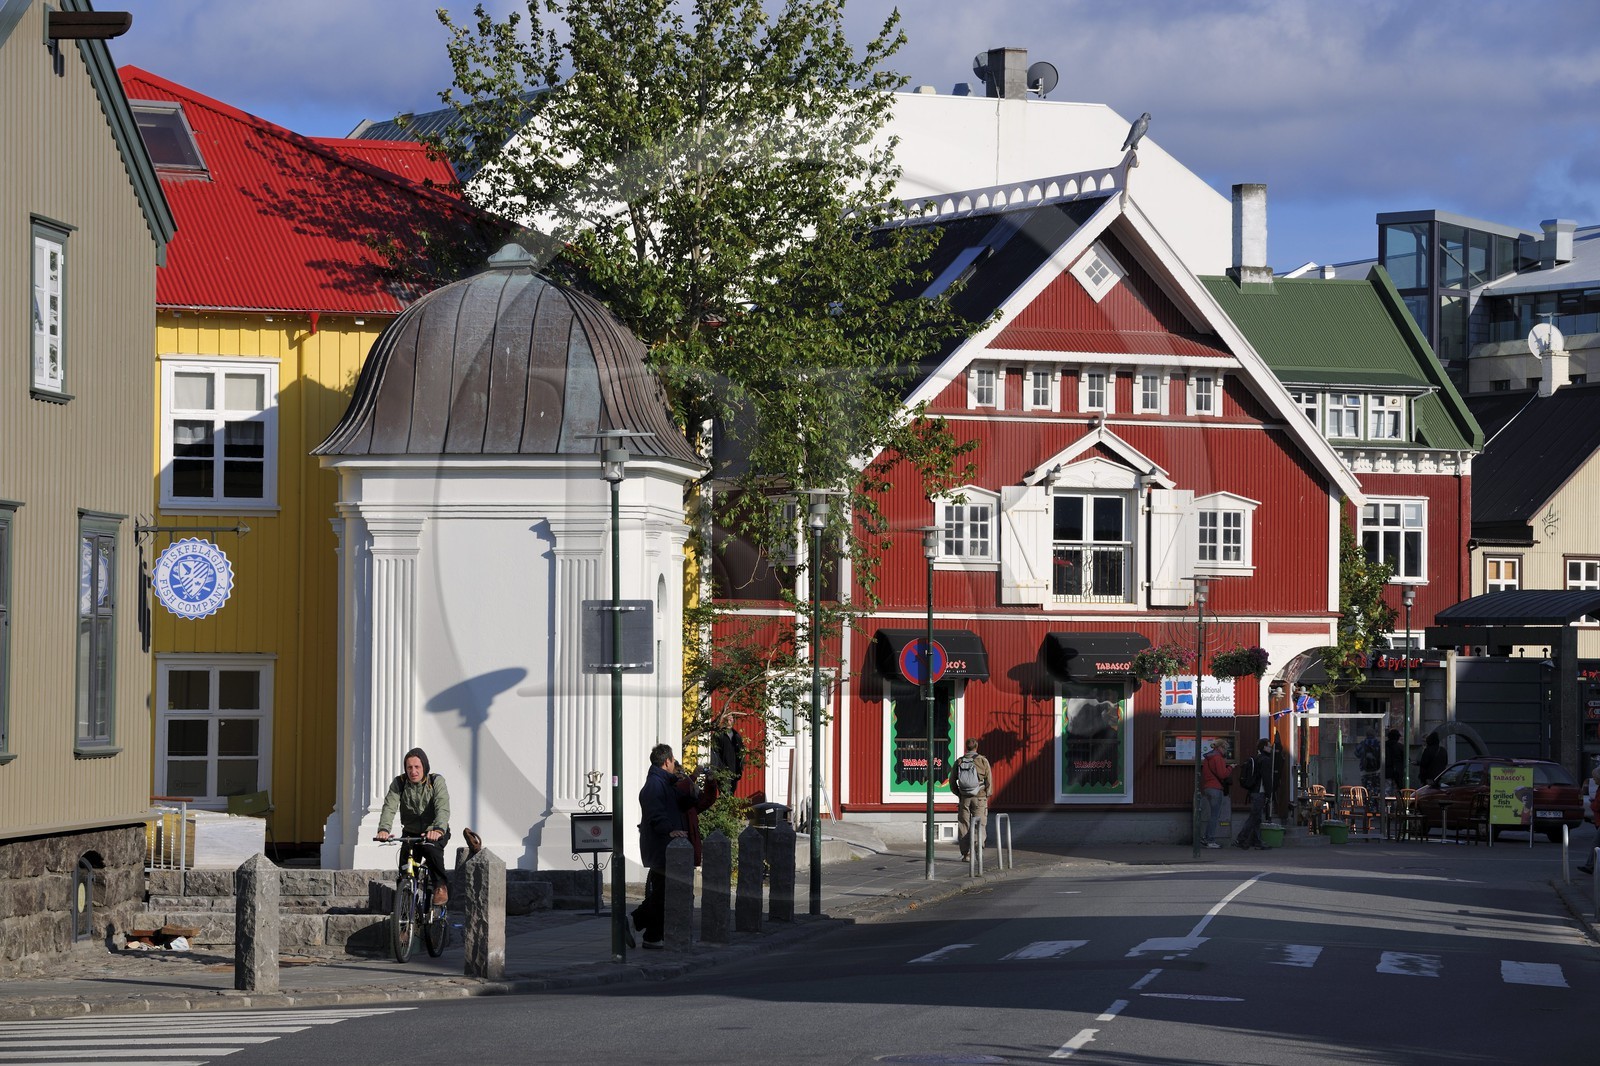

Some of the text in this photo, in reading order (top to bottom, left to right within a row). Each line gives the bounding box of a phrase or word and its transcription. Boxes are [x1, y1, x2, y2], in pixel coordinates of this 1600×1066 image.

[160, 579, 226, 613] FISH COMPANY
[1095, 661, 1133, 670] TABASCO'
[1493, 792, 1514, 801] grilled
